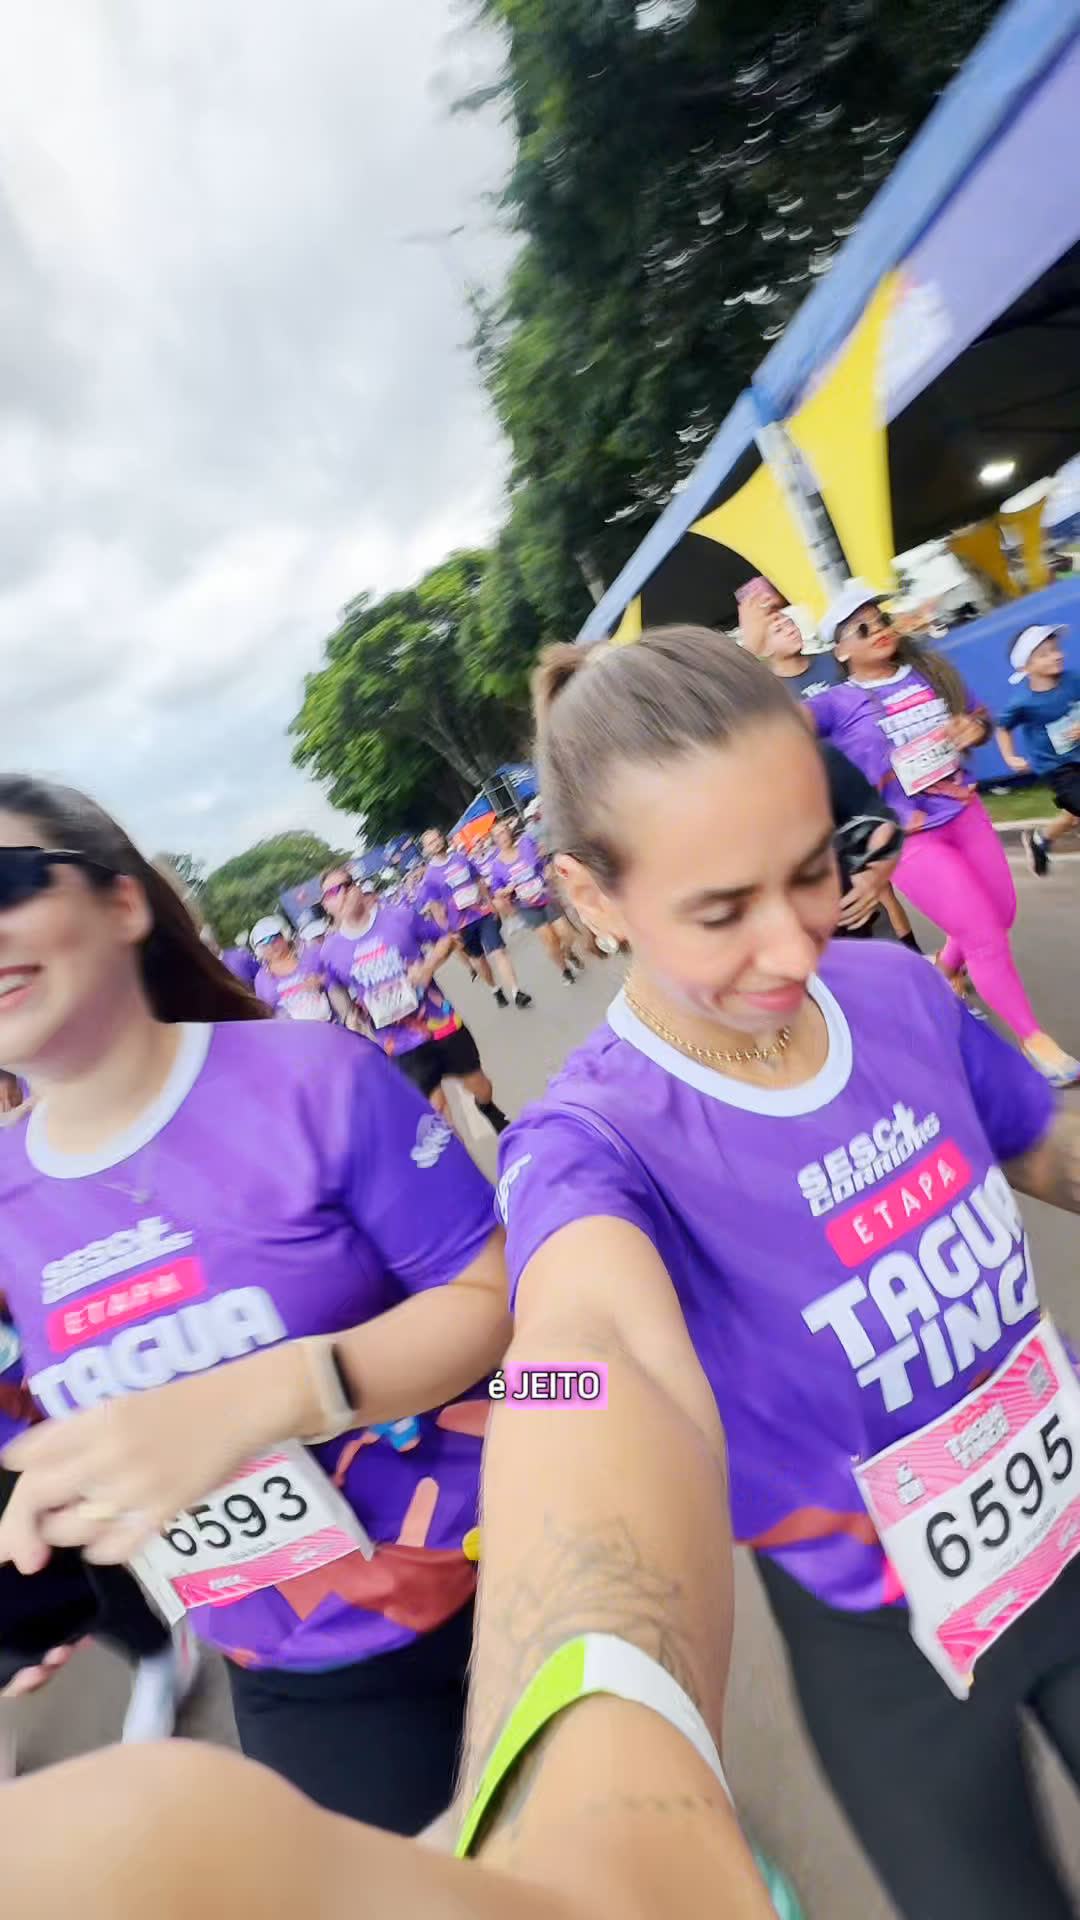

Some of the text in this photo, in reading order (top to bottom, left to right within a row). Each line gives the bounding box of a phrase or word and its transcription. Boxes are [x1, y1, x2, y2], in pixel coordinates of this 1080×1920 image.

[798, 1117, 898, 1201] SESC
[852, 1158, 957, 1245] ETAPA
[27, 1286, 288, 1417] TAGUA
[161, 1476, 308, 1557] 6593
[925, 1413, 1073, 1578] 6595
